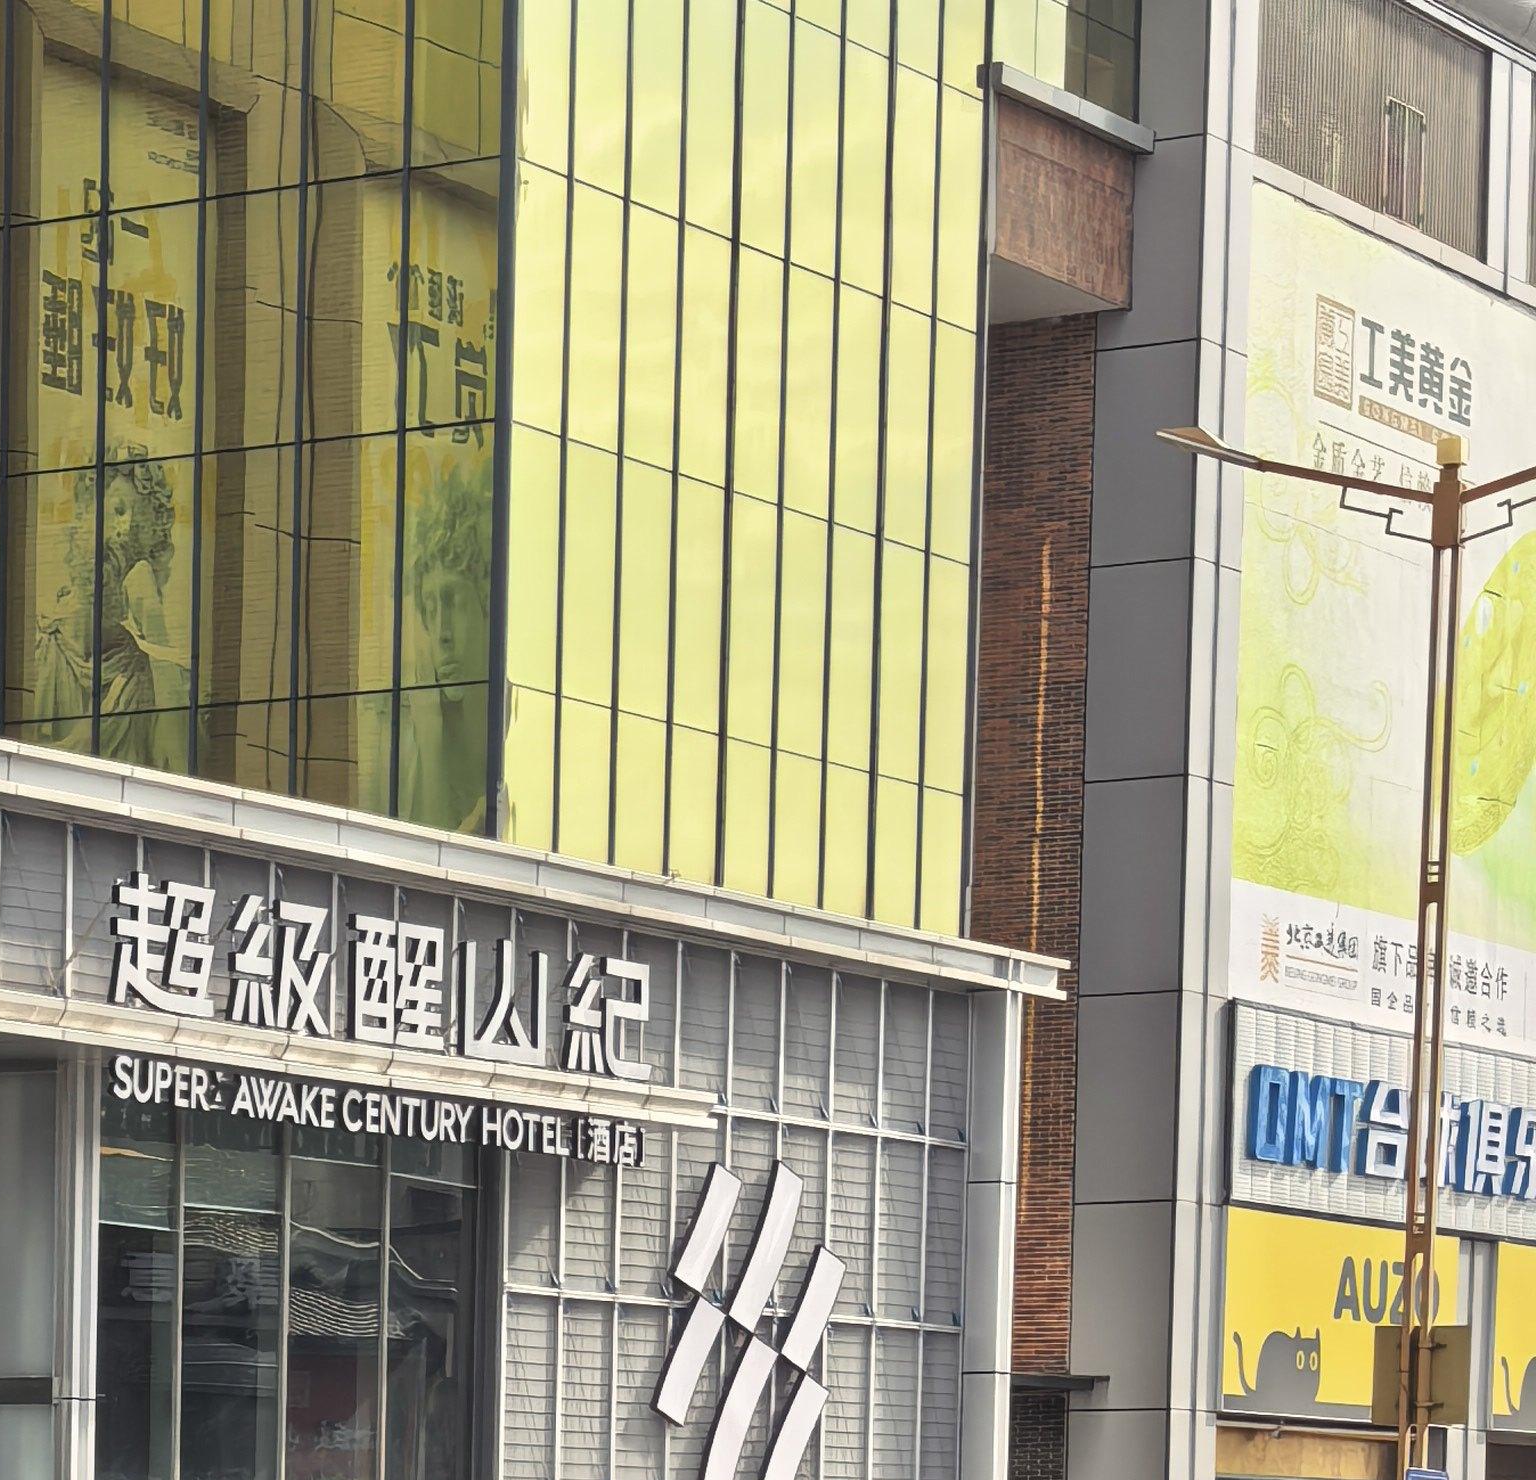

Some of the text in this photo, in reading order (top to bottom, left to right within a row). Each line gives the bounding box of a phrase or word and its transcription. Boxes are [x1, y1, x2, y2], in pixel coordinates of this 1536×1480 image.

[1359, 316, 1473, 428] 工美黄金
[230, 1075, 336, 1130] AWAKE
[341, 1089, 474, 1145] CENTURY
[481, 1106, 569, 1157] HOTEL
